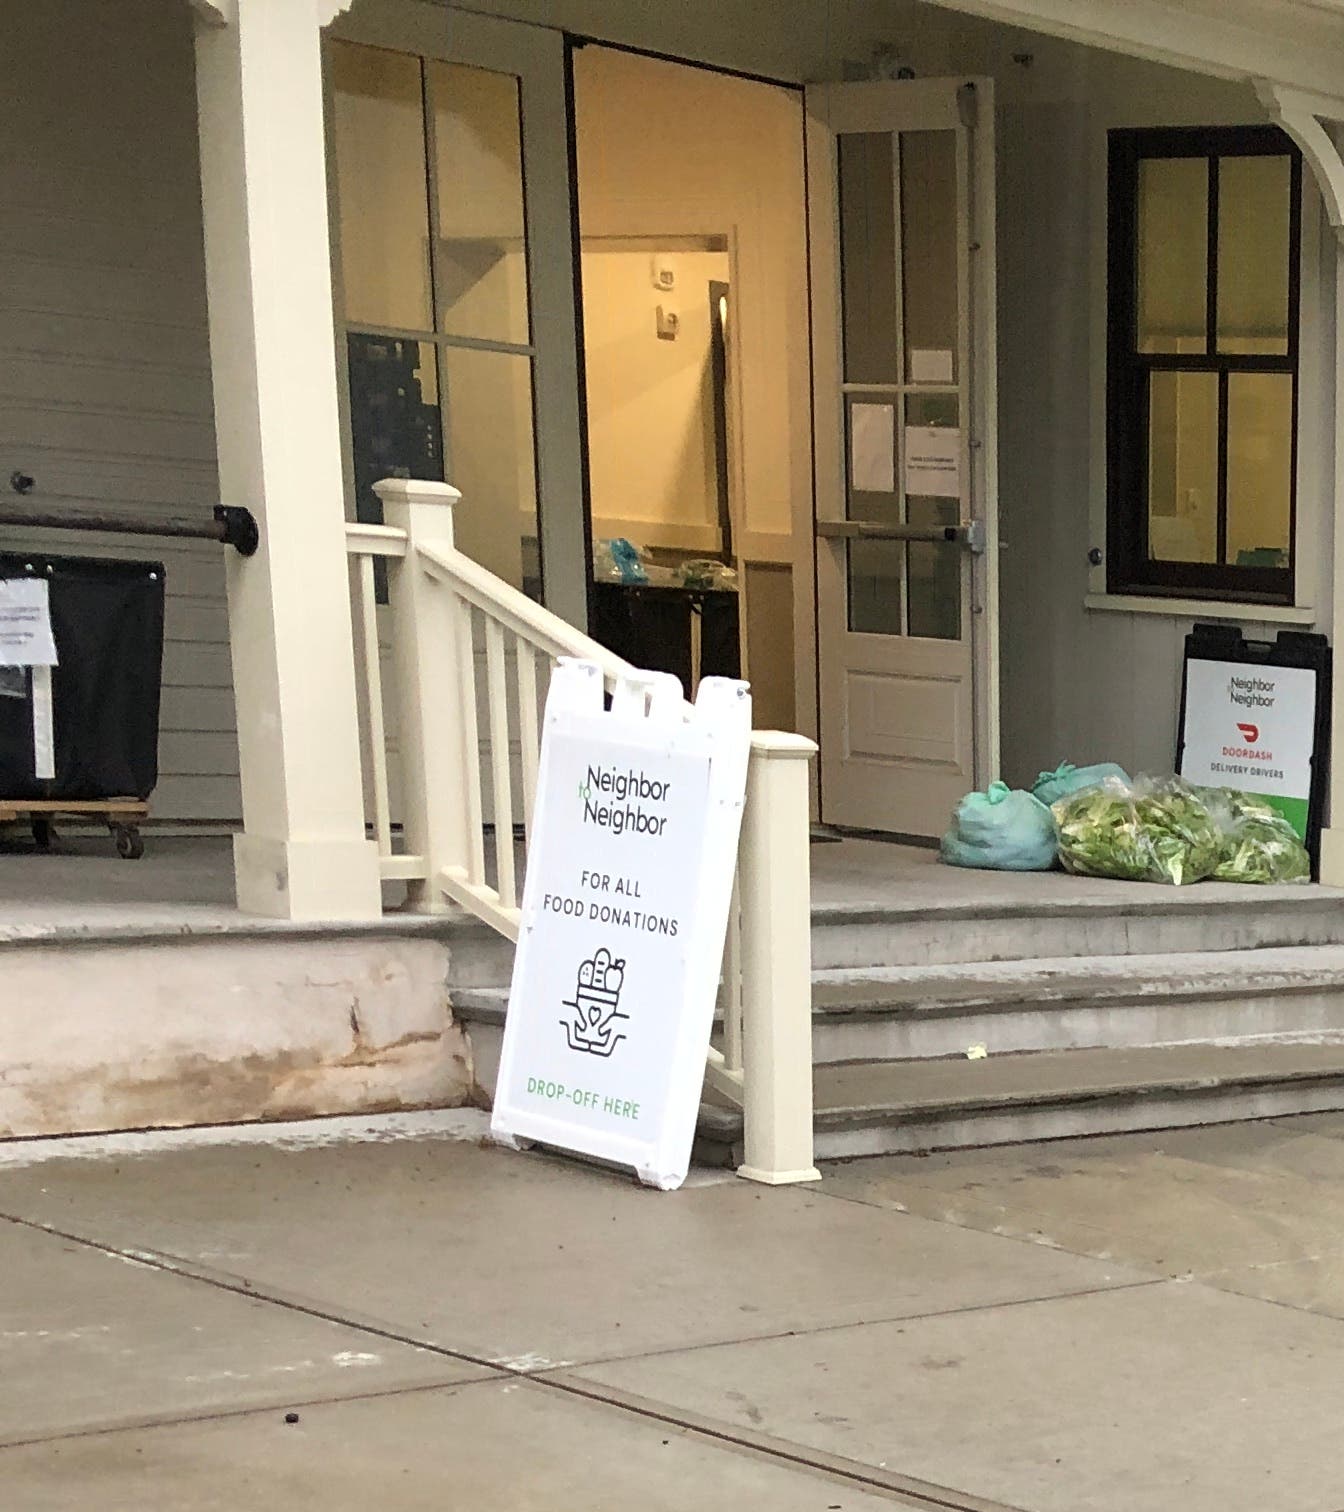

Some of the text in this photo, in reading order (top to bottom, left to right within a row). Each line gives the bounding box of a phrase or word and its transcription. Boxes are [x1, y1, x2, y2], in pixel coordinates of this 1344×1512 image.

[1230, 676, 1276, 693] Neighbor
[1229, 691, 1275, 708] Neighbor
[1222, 747, 1273, 761] DOORDASH
[586, 764, 671, 802] Neighbor
[1210, 762, 1284, 779] DELIVERY DRIVERS
[583, 798, 667, 837] Neighbor
[580, 869, 642, 898] FOR ALL
[543, 893, 679, 937] FOOD DONATIONS
[526, 1076, 641, 1121] DROP-OFF HERE
